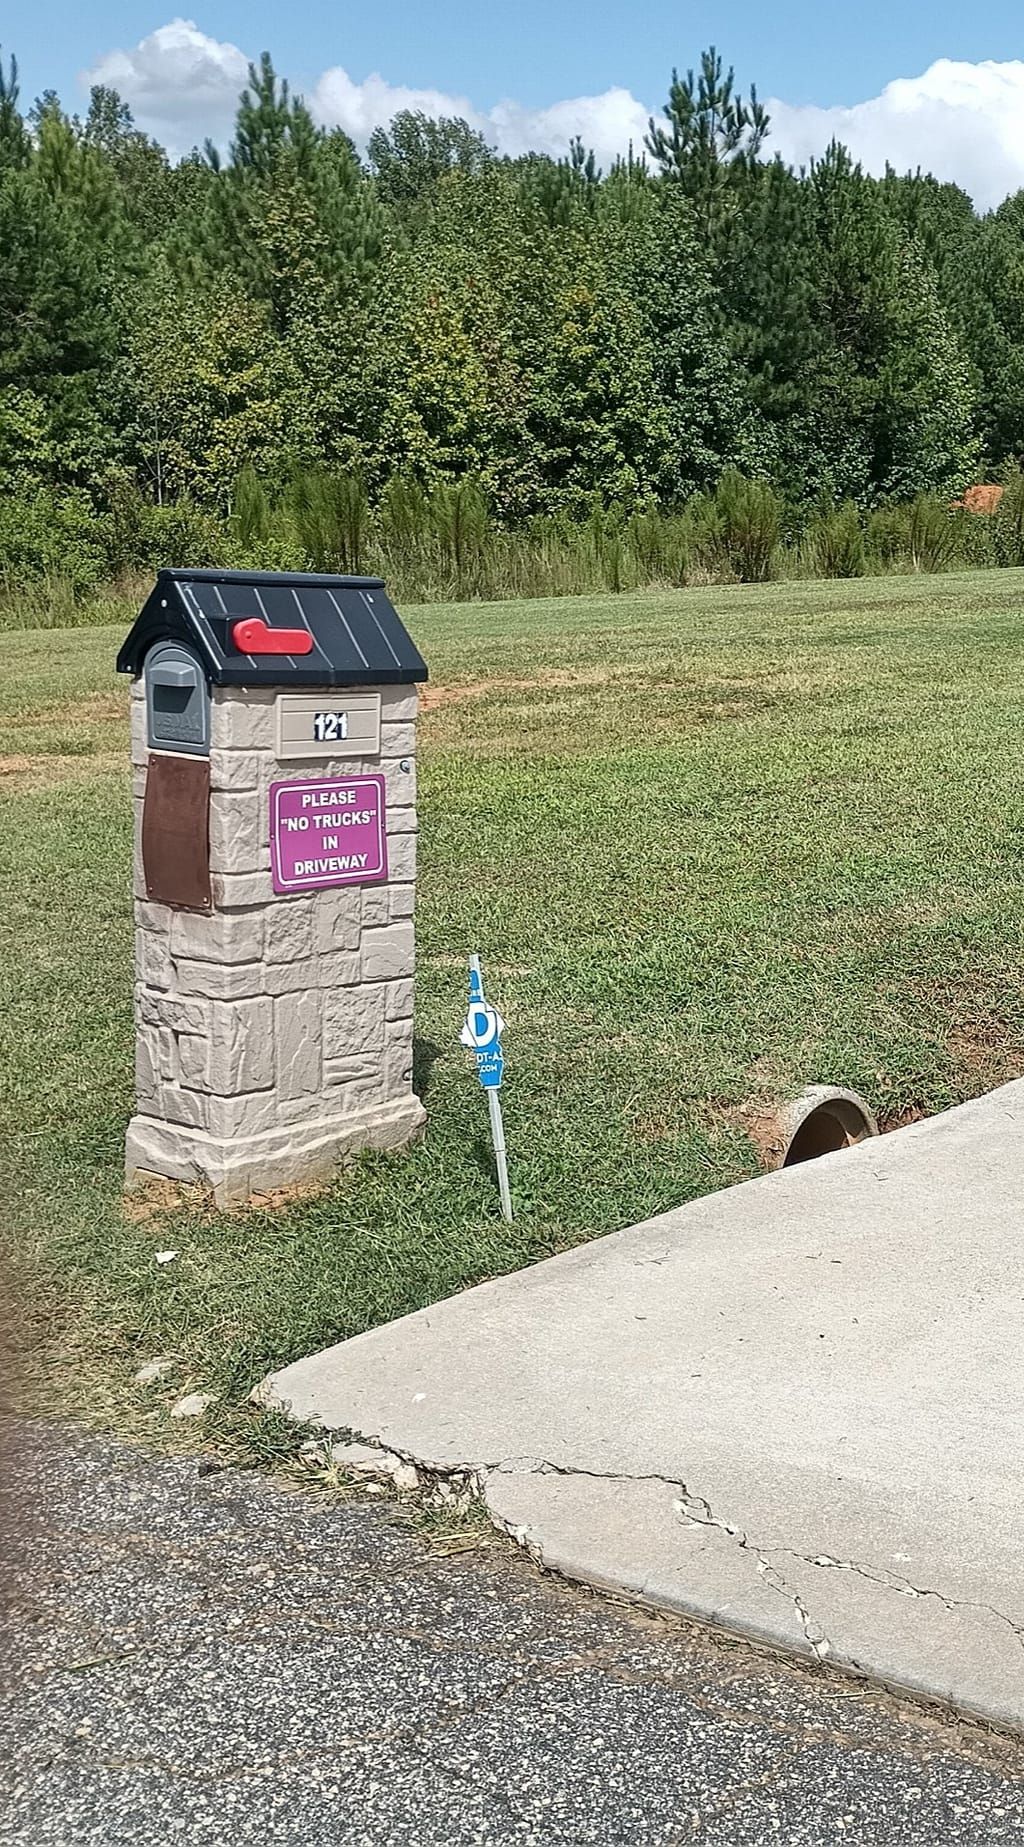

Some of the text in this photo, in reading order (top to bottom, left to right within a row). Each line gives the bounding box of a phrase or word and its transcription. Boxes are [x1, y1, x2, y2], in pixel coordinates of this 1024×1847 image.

[314, 713, 348, 741] 121
[302, 791, 356, 808] PLEASE
[281, 809, 376, 832] "NO TRUCKS"
[322, 835, 339, 850] IN
[294, 853, 368, 876] DRIVEWAY
[476, 1051, 502, 1063] DT-A
